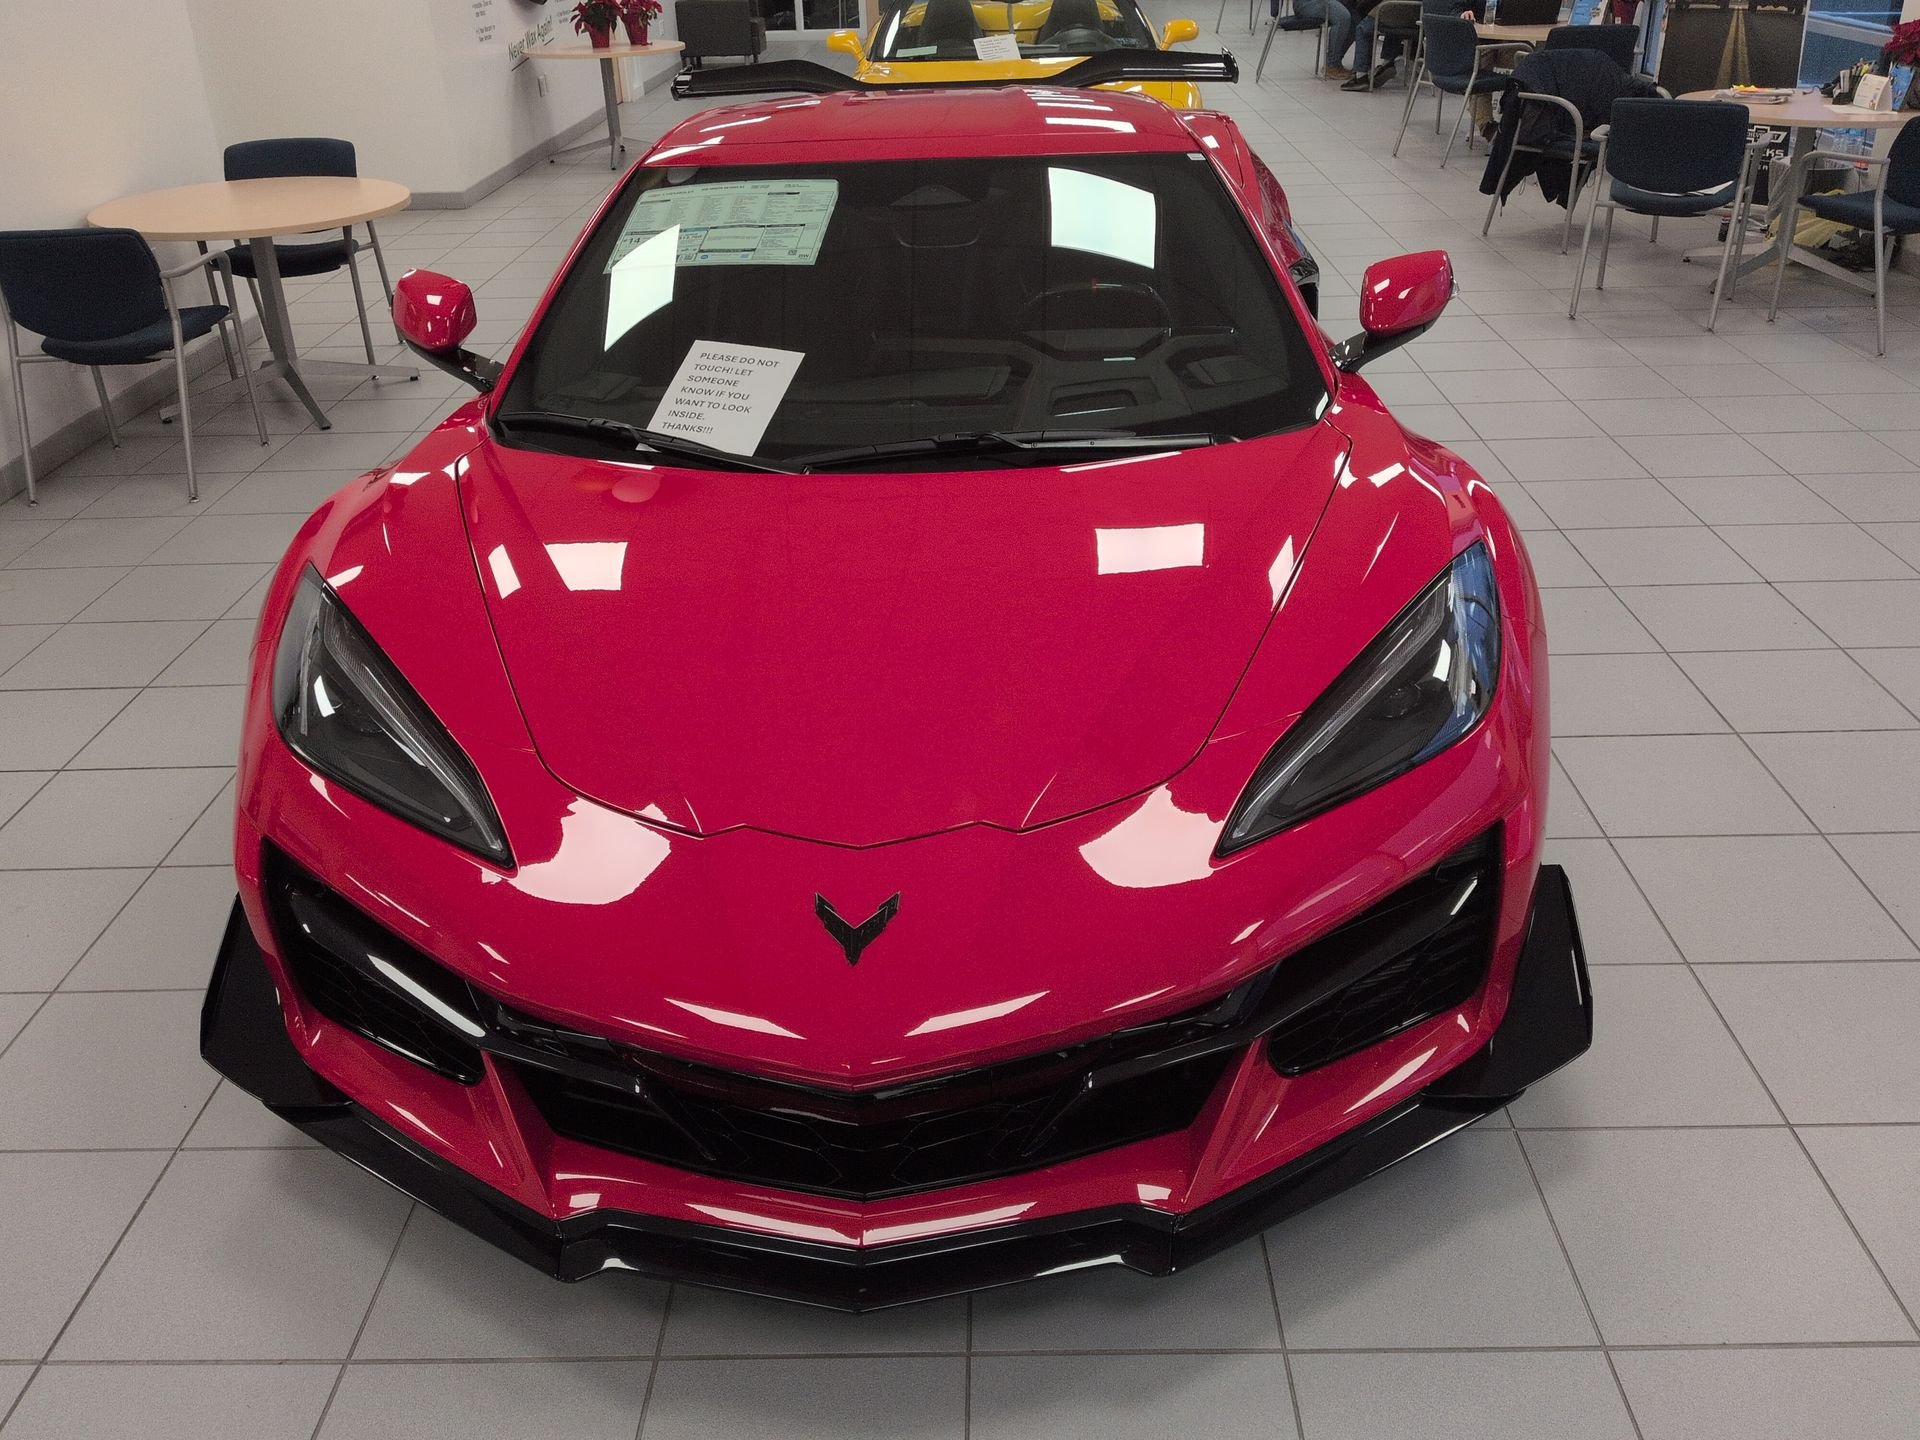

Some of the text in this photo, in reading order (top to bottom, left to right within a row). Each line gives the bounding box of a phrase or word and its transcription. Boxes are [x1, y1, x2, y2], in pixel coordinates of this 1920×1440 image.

[700, 352, 780, 368] PLEASE DO NOT
[694, 363, 754, 377] TOUCH! LET
[687, 375, 740, 387] SOMEONE
[680, 386, 715, 396] KNOW
[728, 392, 750, 401] YOU
[674, 397, 753, 414] WANT TO LOOK
[667, 410, 706, 420] INSIDE.
[661, 421, 714, 434] THANKS!!!
